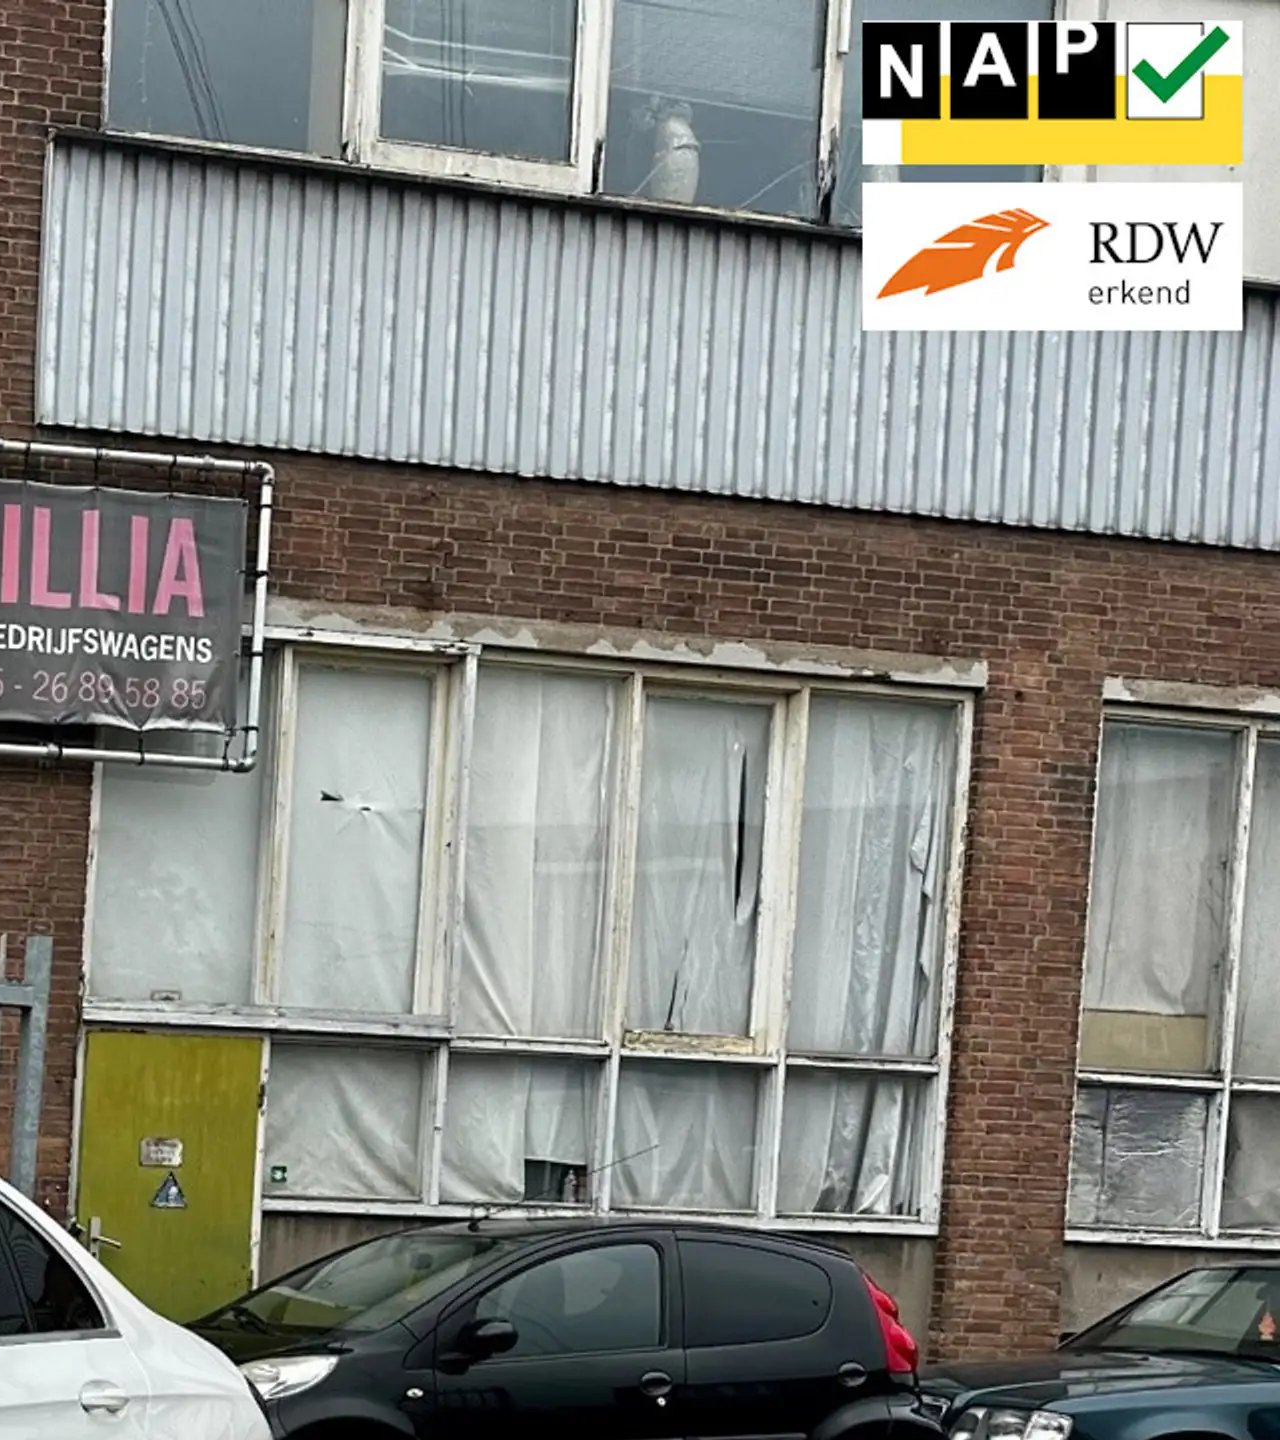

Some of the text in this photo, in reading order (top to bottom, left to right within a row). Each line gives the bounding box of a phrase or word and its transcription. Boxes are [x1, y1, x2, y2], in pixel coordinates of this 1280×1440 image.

[32, 670, 68, 703] 26
[78, 671, 115, 704] 89
[125, 677, 161, 708] 58
[171, 678, 207, 709] 85
